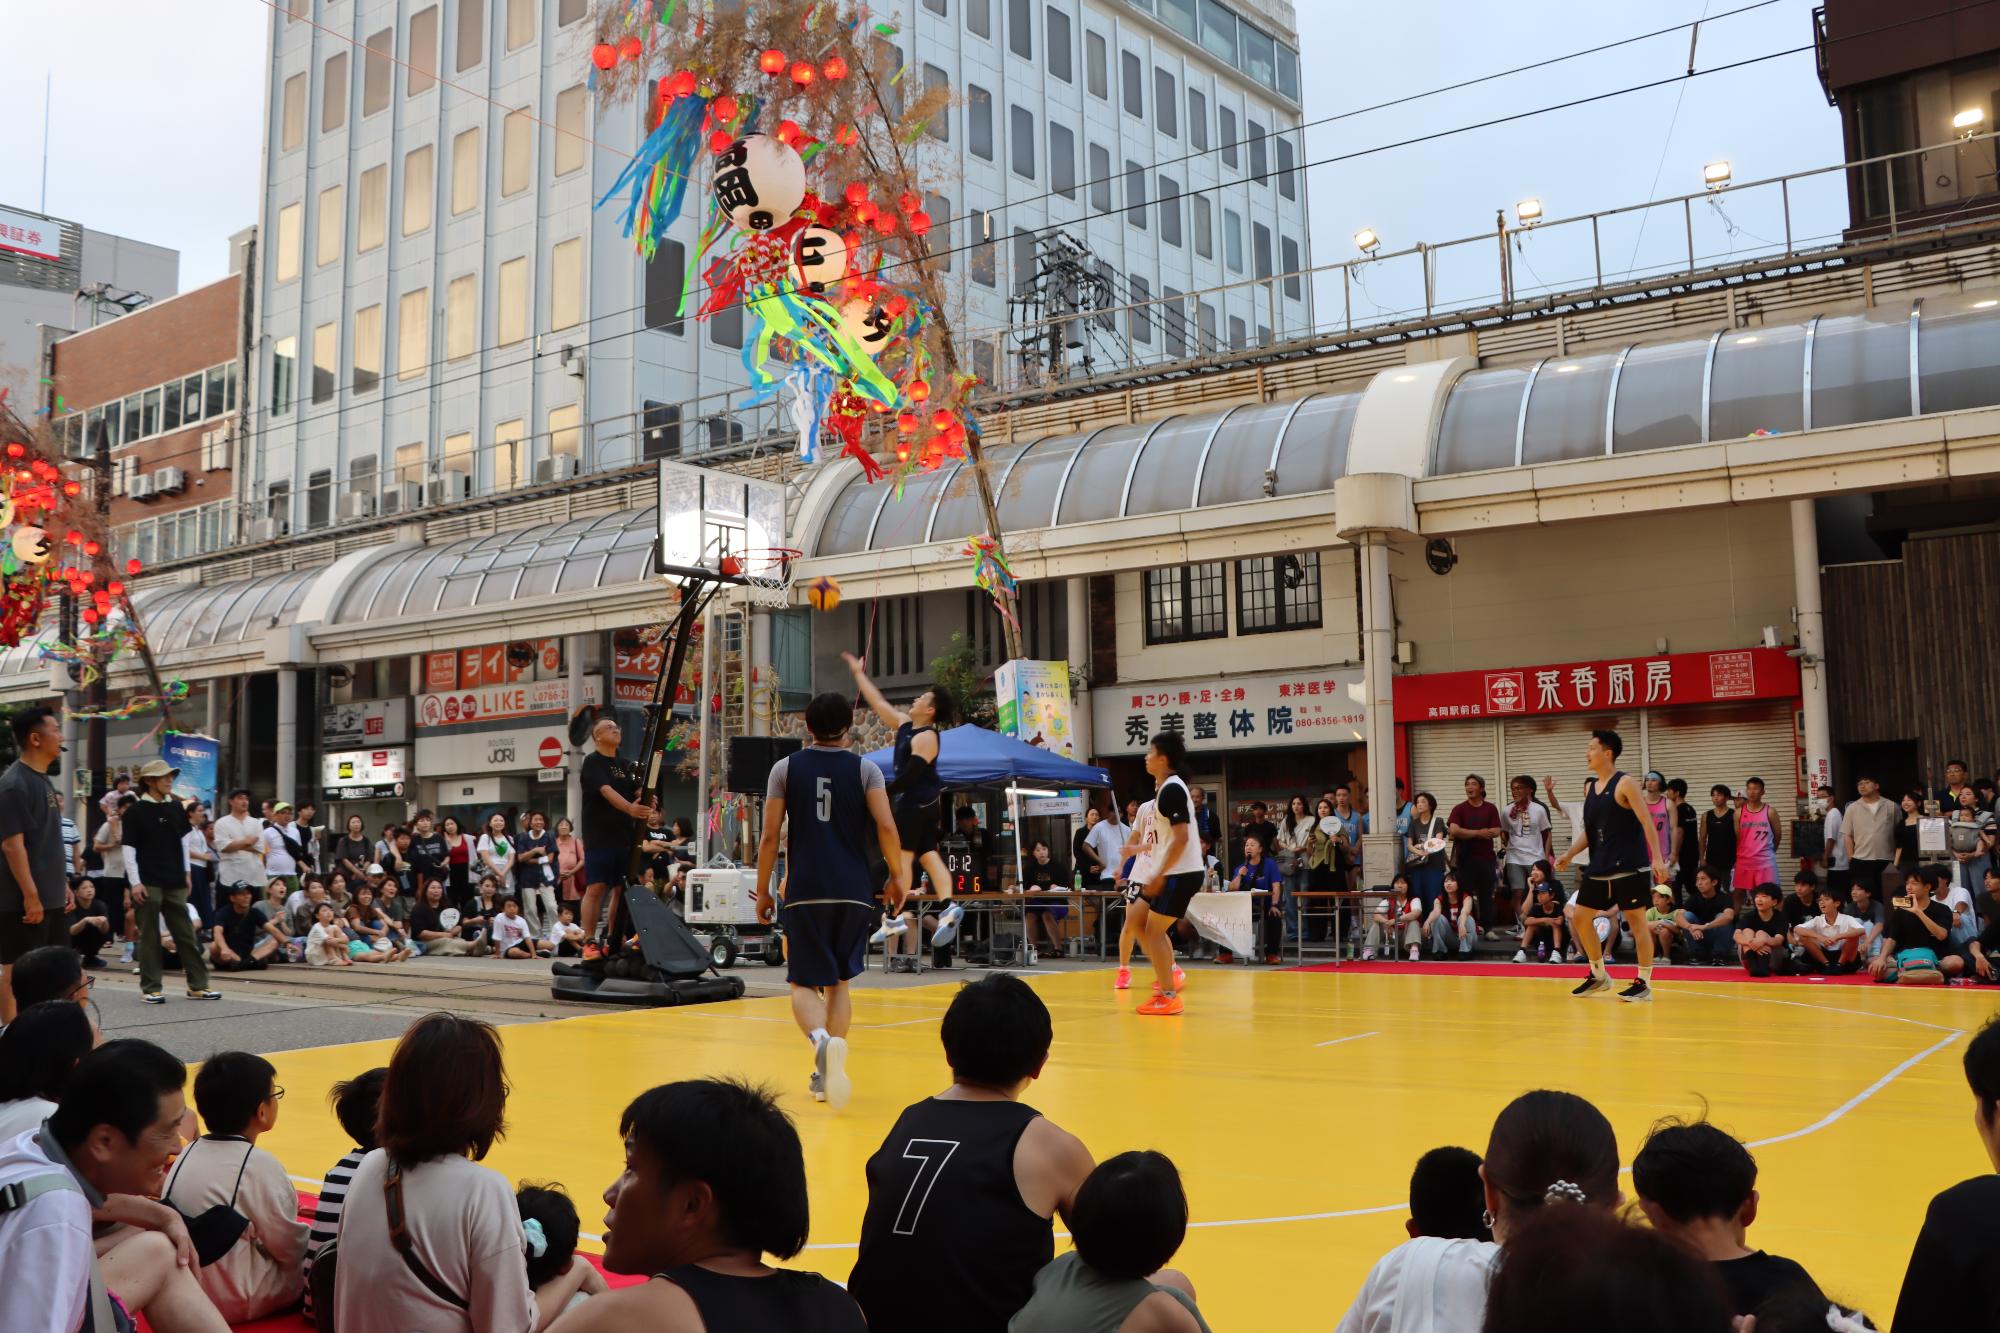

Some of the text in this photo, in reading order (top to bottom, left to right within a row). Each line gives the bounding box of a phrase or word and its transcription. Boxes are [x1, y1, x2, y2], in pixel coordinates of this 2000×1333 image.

[1279, 680, 1336, 698] 東洋医学
[1534, 660, 1673, 710] 菜香厨房
[482, 690, 525, 714] LIKE
[1428, 704, 1481, 717] 高岡駅前店
[1124, 705, 1293, 747] 秀美整体院
[488, 747, 515, 764] JORI
[816, 776, 832, 822] 5
[1753, 830, 1768, 841] 77
[949, 854, 972, 872] 0:12
[958, 875, 981, 892] 2 6
[892, 1138, 961, 1236] 7
